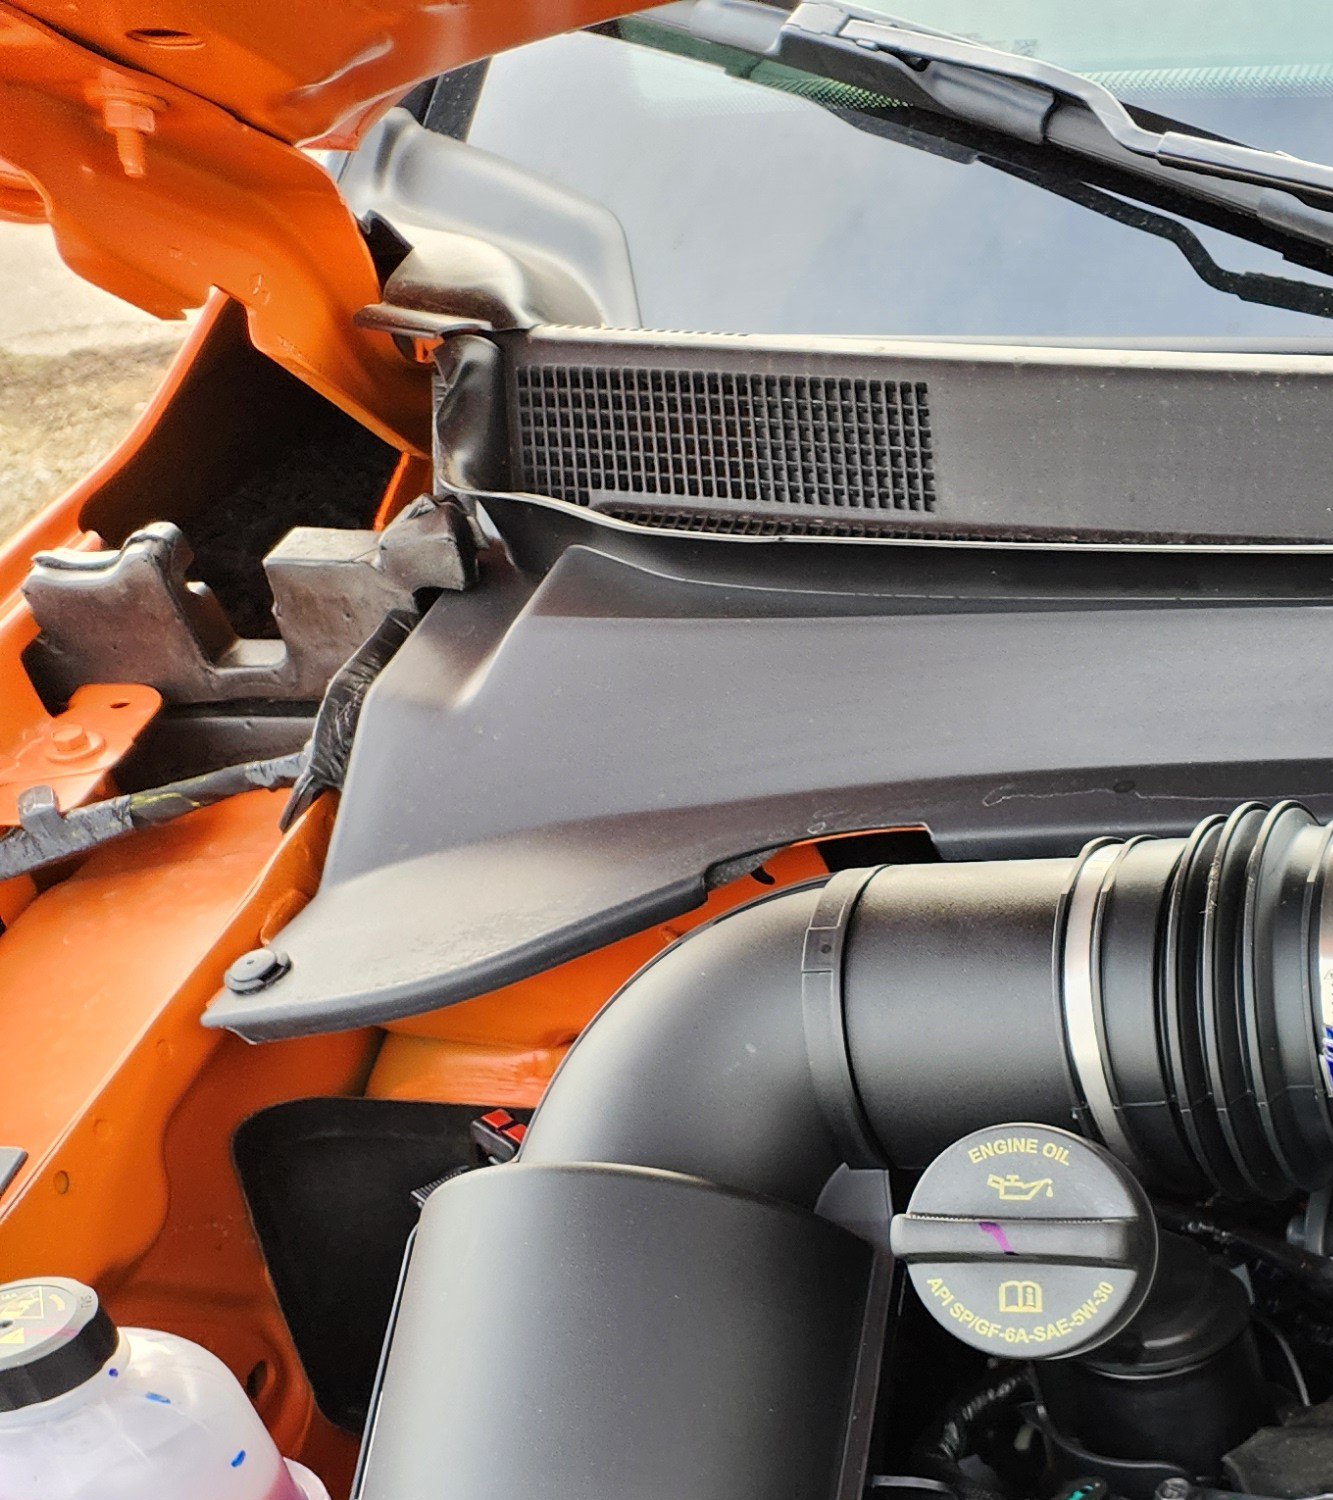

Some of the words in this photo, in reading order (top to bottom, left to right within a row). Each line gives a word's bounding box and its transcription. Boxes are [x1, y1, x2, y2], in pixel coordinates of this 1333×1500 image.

[968, 1137, 1039, 1164] ENGINE
[1042, 1141, 1071, 1166] OIL
[928, 1277, 952, 1306] API
